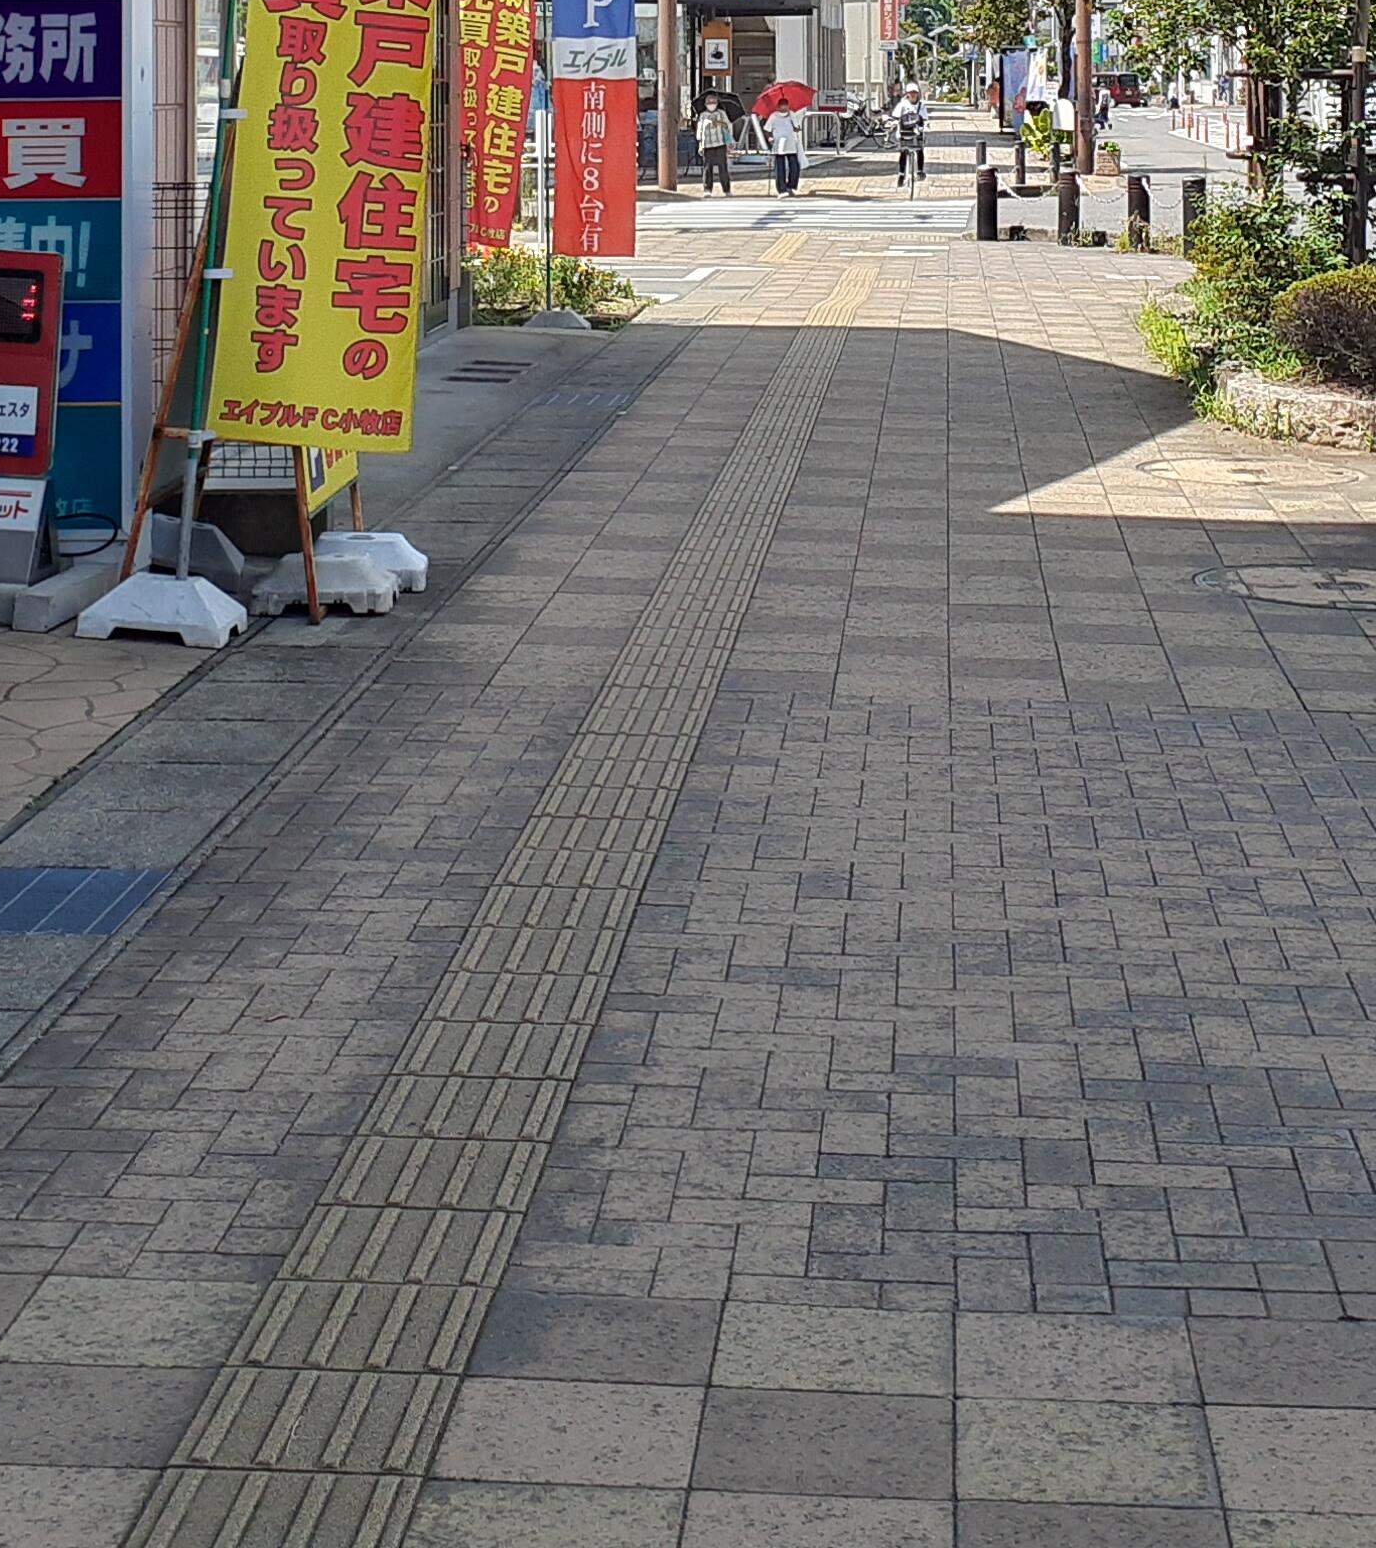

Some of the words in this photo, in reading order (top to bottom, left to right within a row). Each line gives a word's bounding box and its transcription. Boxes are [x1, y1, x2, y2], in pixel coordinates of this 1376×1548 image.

[563, 43, 628, 75] エイブル
[580, 82, 606, 253] 南側に8台有
[221, 398, 403, 439] エイブルFC小牧店
